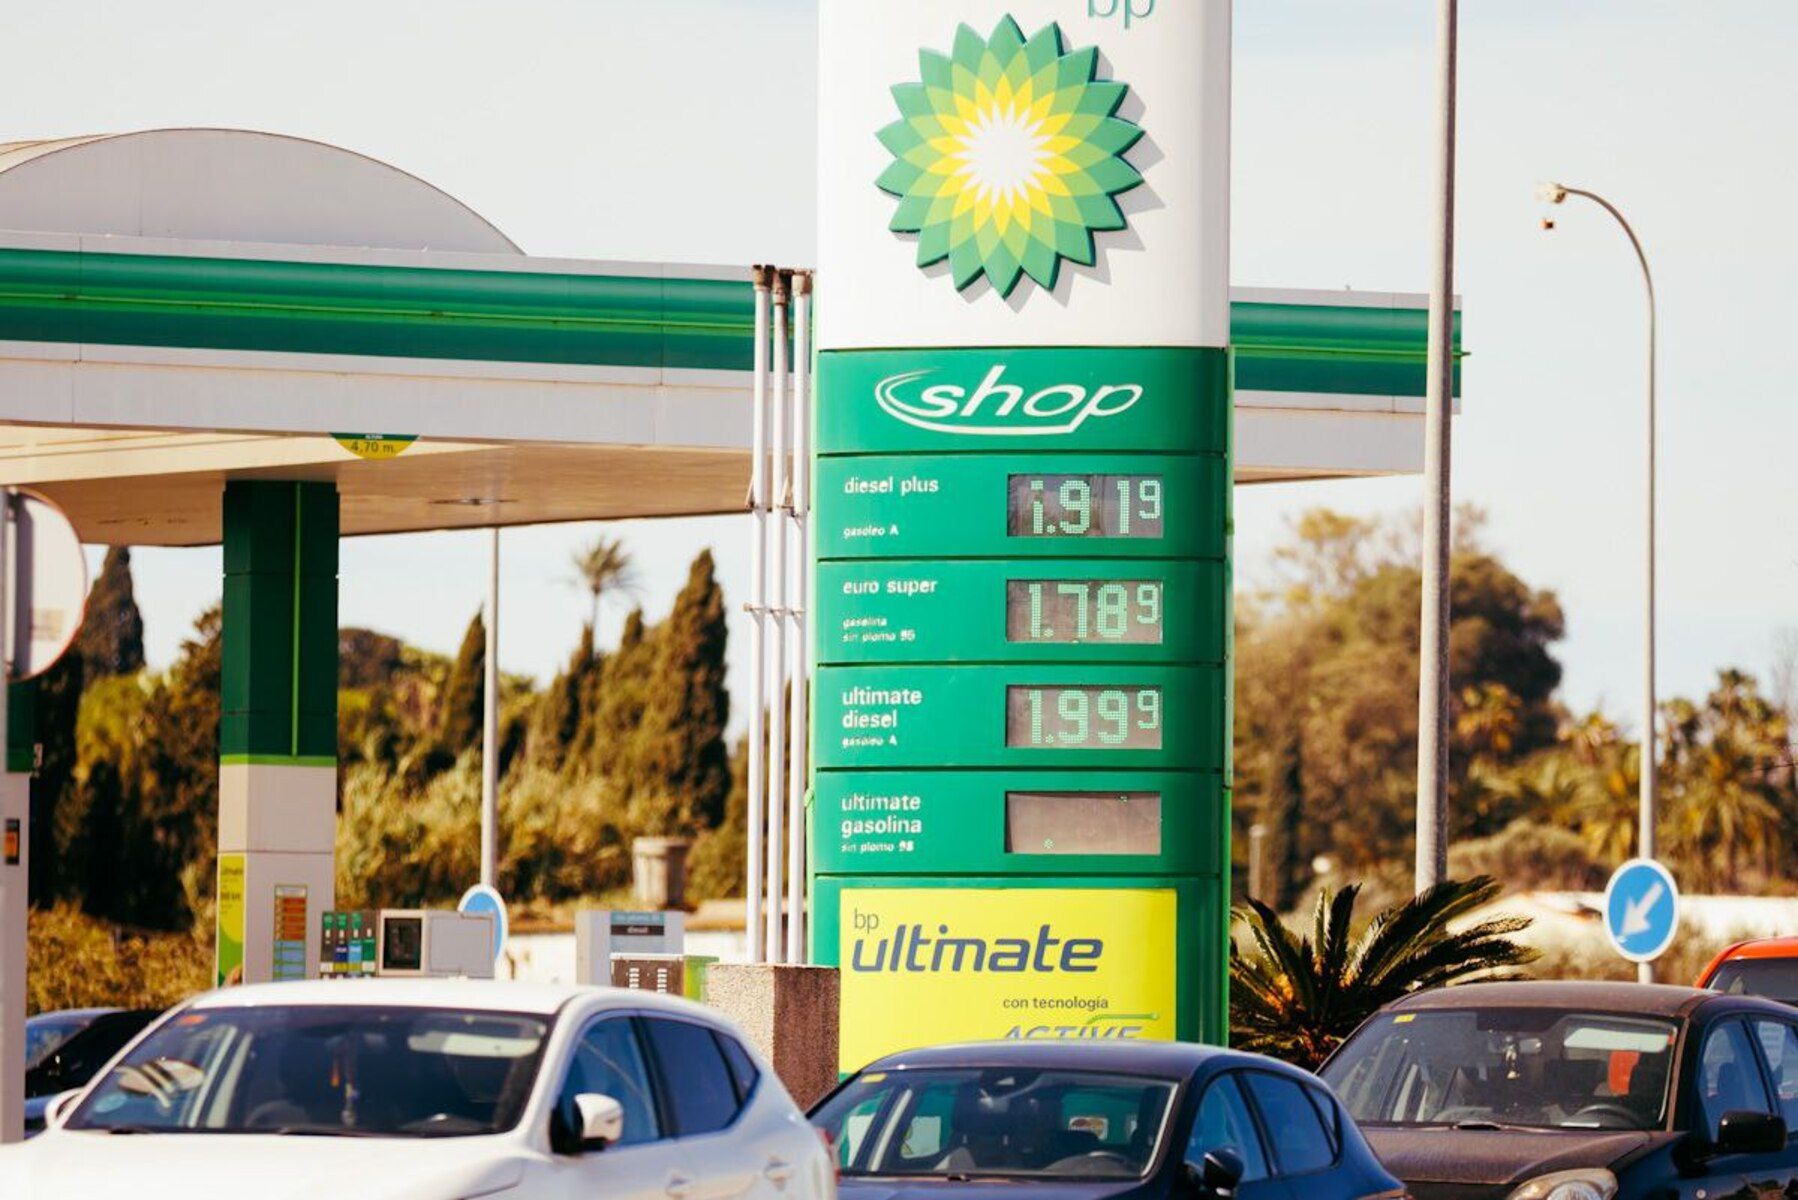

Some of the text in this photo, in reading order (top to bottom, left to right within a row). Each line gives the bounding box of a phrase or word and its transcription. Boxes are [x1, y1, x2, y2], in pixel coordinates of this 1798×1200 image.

[875, 365, 1144, 435] shop
[844, 476, 939, 497] diesel plus
[889, 524, 899, 536] A
[843, 580, 938, 597] euro super
[1028, 584, 1160, 638] 1.789
[842, 686, 923, 705] ultimate
[842, 709, 898, 728] diesel
[1028, 689, 1160, 744] 1.999
[841, 792, 922, 811] ultimate
[841, 815, 922, 838] gasolina
[854, 908, 879, 934] bp
[852, 924, 1104, 972] ultimate
[1002, 998, 1029, 1009] con
